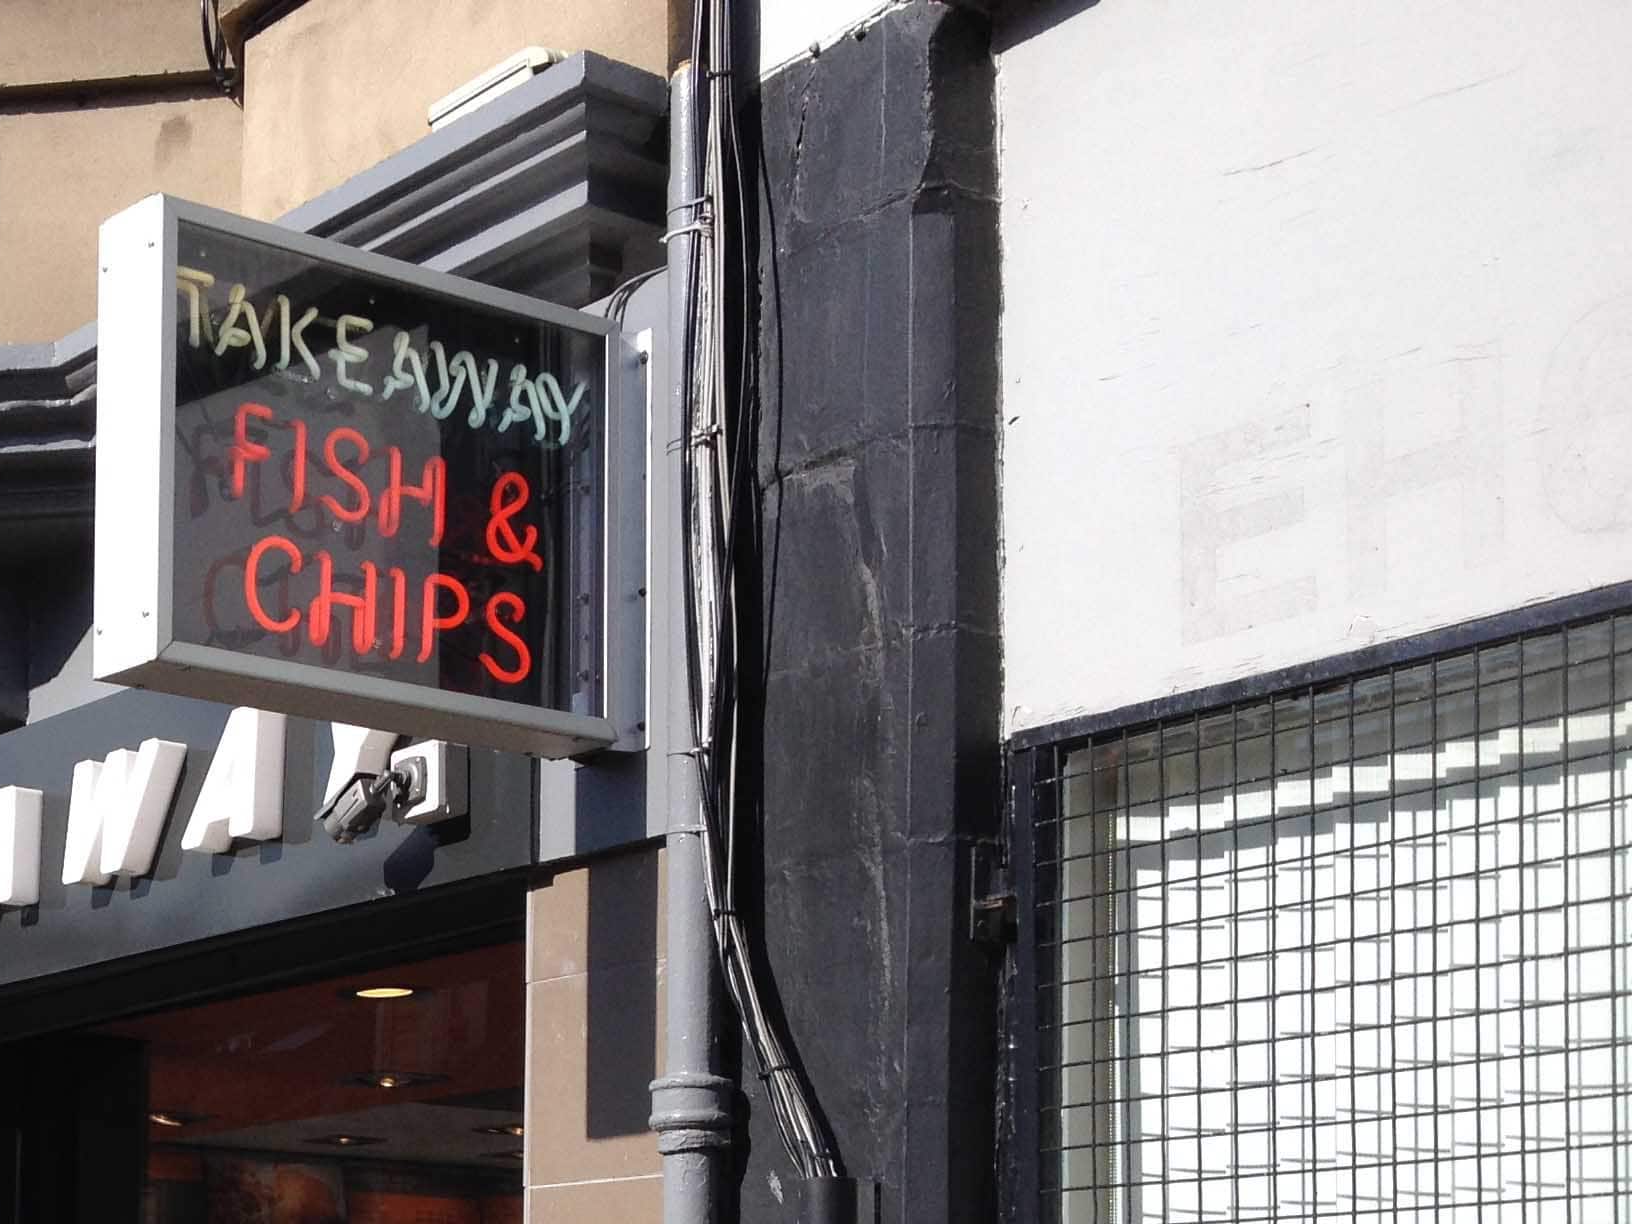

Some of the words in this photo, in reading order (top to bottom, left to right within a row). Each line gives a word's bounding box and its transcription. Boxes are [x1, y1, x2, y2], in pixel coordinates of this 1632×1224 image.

[175, 265, 588, 444] TAKEAWAY
[232, 402, 447, 547] FISH
[485, 471, 543, 571] &
[244, 535, 532, 684] CHIPS
